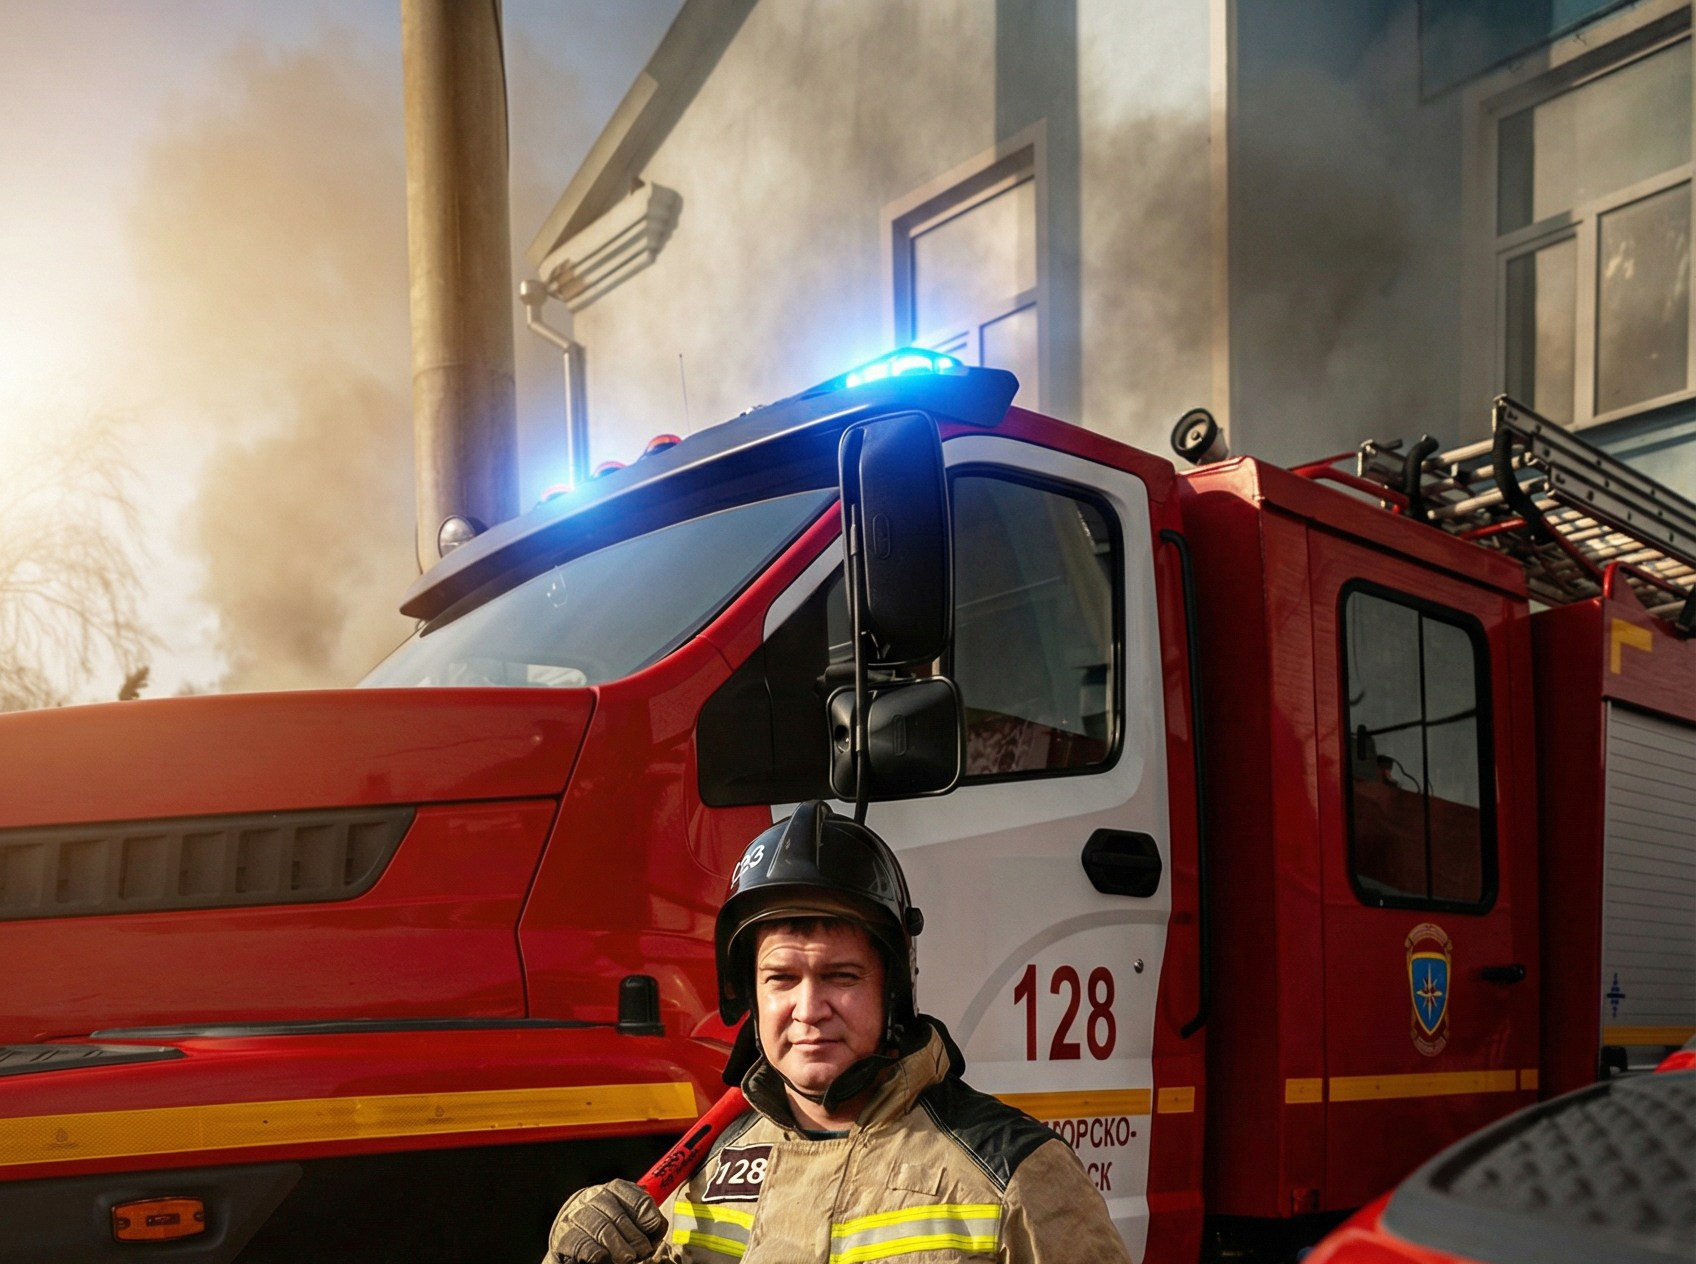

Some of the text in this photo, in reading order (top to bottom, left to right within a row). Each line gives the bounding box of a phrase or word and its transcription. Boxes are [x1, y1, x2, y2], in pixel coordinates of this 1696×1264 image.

[1014, 964, 1117, 1061] 128
[1041, 1116, 1137, 1150] ОРСКО-
[715, 1157, 768, 1185] 128
